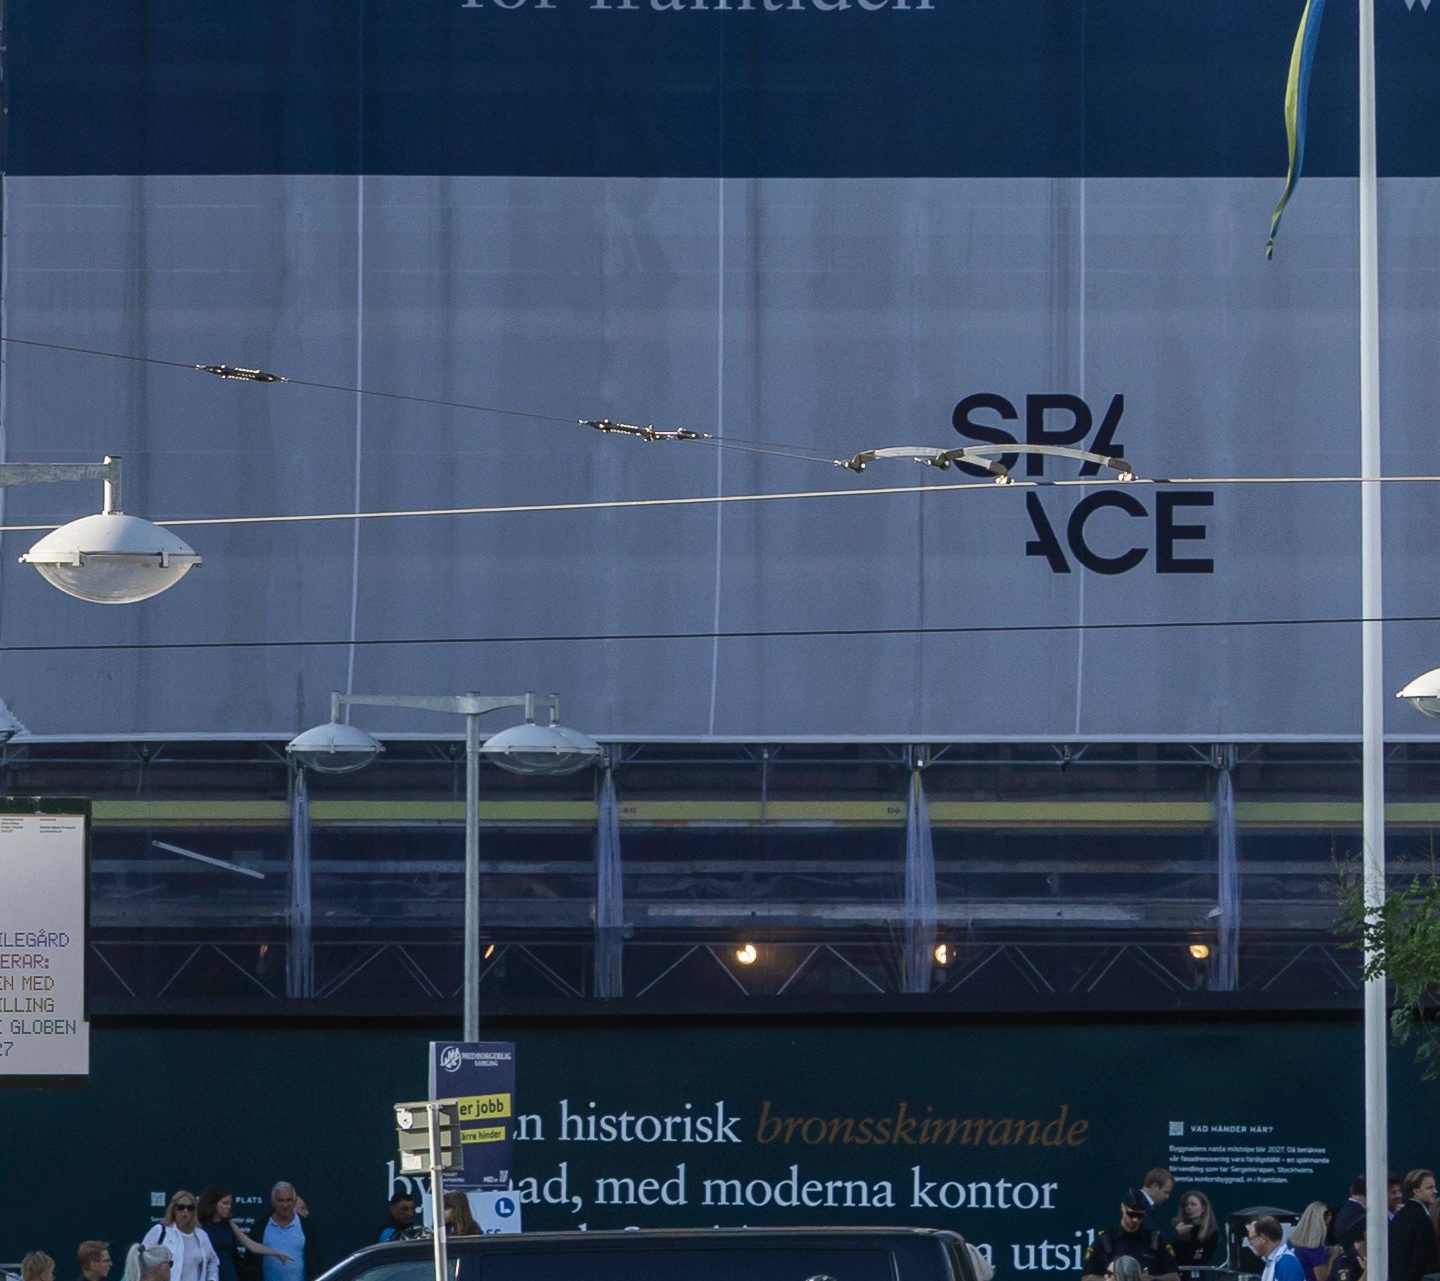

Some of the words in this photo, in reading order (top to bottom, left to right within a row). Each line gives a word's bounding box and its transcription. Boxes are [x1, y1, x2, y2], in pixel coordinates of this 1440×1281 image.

[21, 975, 55, 991] MED
[9, 1019, 77, 1035] GLOBEN
[459, 1104, 474, 1116] er
[475, 1098, 505, 1117] jobb
[513, 1114, 544, 1142] n
[558, 1100, 742, 1143] historisk
[755, 1101, 1089, 1147] bronsskimrande
[478, 1128, 502, 1139] hinder
[594, 1163, 684, 1207] med
[701, 1163, 895, 1207] moderna
[909, 1164, 1059, 1209] kontor
